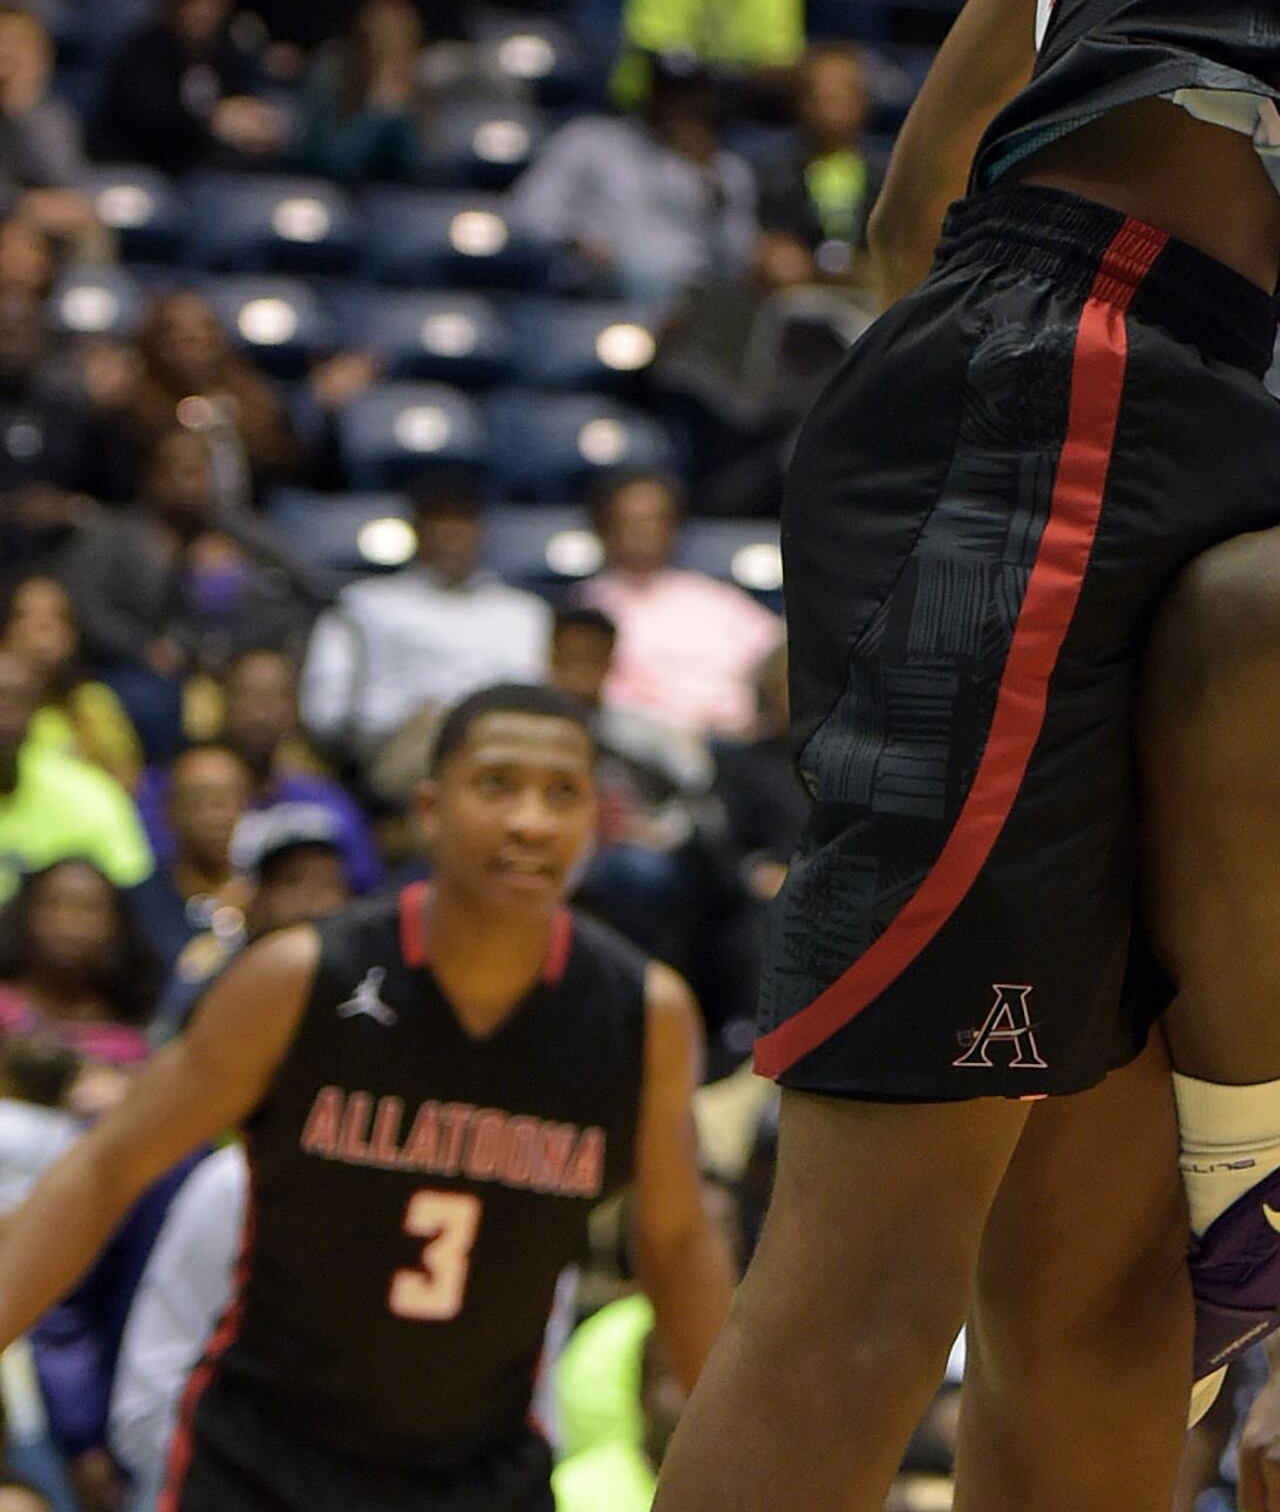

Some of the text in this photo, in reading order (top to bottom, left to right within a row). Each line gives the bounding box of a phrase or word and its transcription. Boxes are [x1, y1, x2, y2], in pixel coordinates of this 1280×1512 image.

[952, 983, 1049, 1069] A
[300, 1085, 607, 1199] ALLATOONA
[388, 1188, 483, 1322] 3
